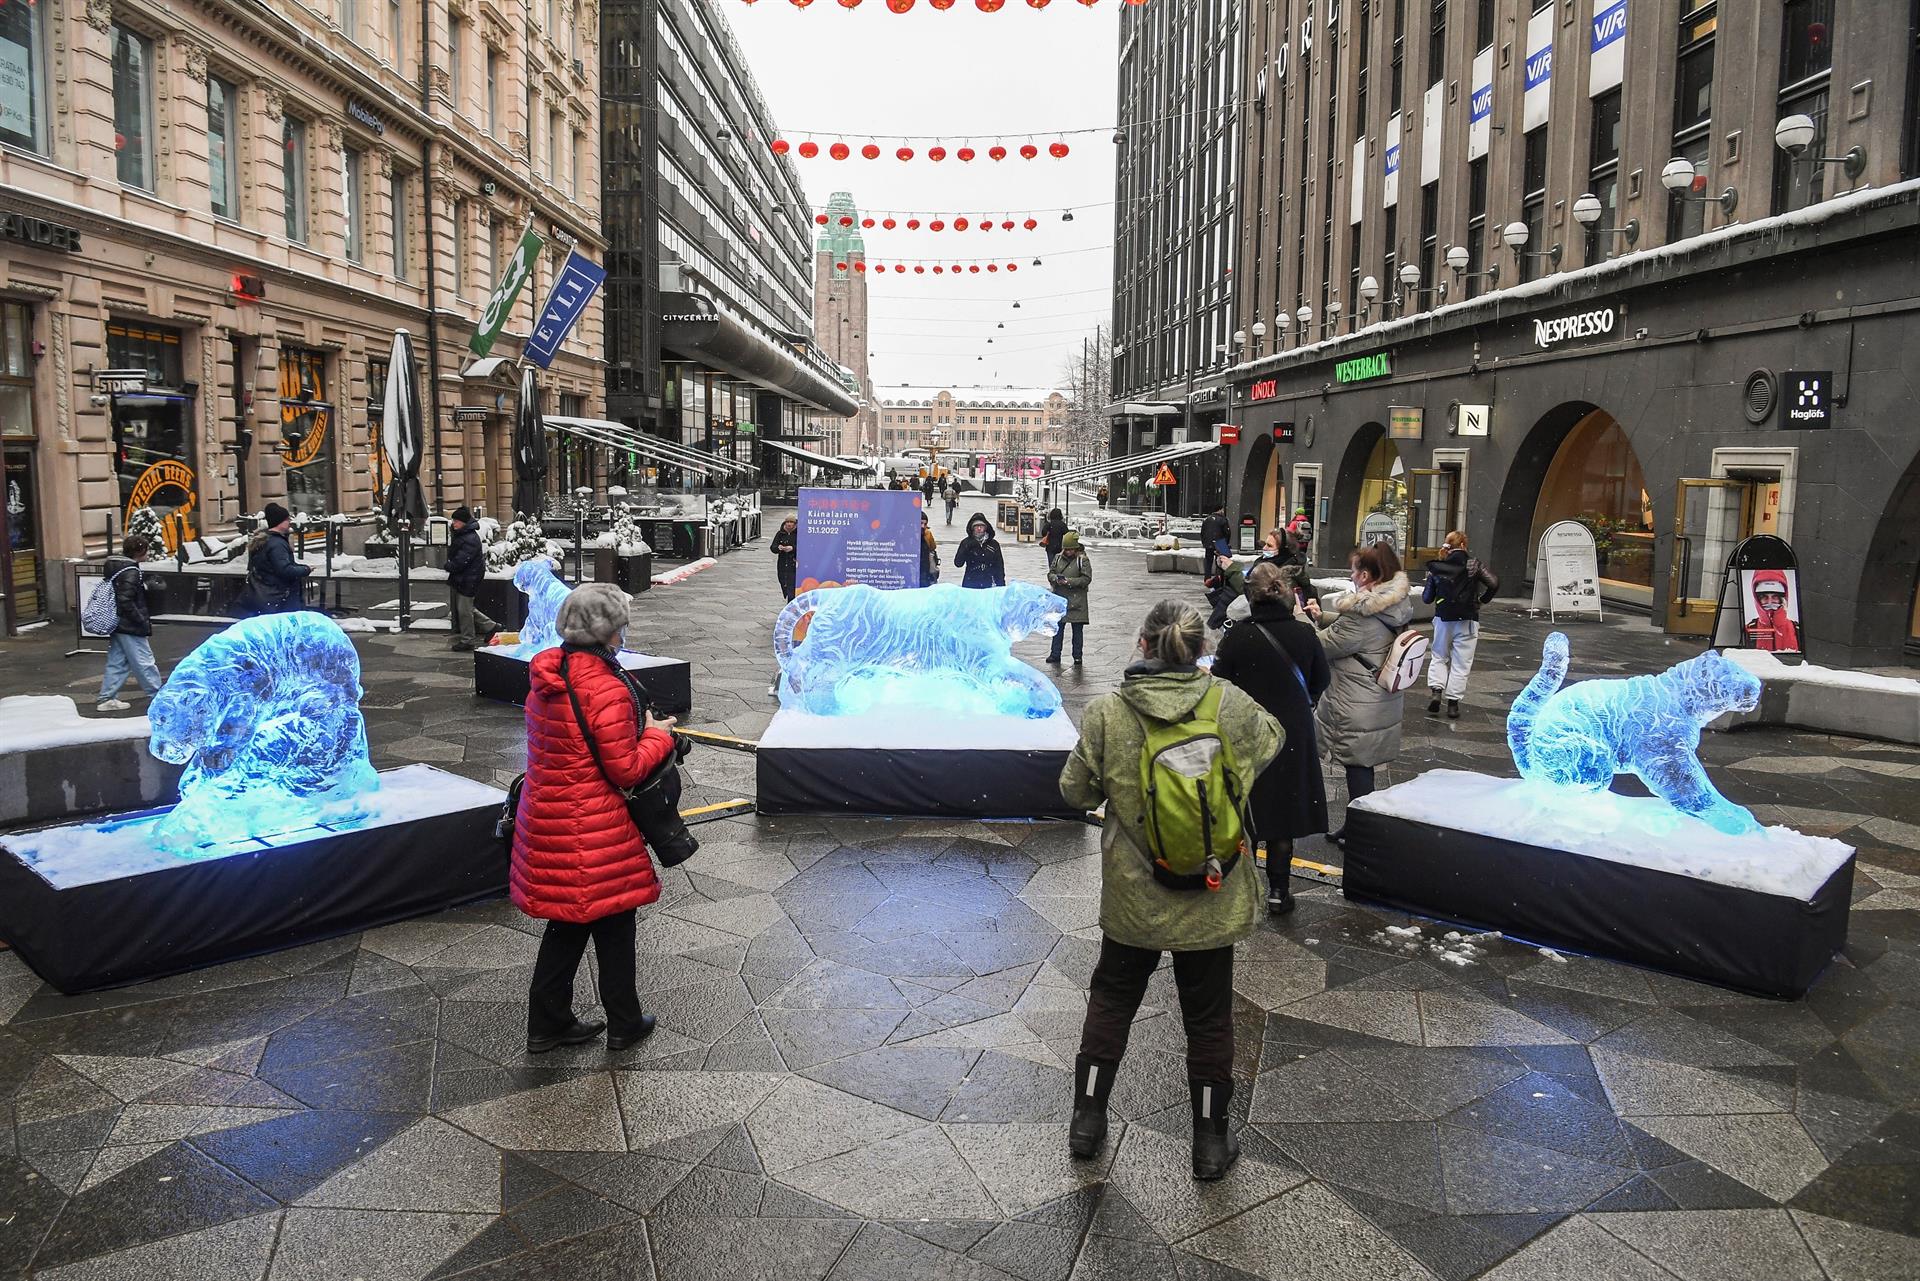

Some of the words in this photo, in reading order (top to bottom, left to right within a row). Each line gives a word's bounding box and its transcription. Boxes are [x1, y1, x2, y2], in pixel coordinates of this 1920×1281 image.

[348, 100, 385, 136] MobilePay
[537, 279, 584, 342] EVLI
[662, 313, 720, 322] CITYCENTER
[1533, 308, 1614, 348] NESPRESSO
[1335, 352, 1388, 383] WESTERBACK
[1251, 380, 1277, 400] LINDEX
[458, 412, 487, 421] STONES
[1790, 409, 1825, 421] Haglöfs
[164, 465, 192, 488] BEERS
[807, 510, 859, 519] Kiinalainen
[807, 527, 839, 535] 31.1.2022
